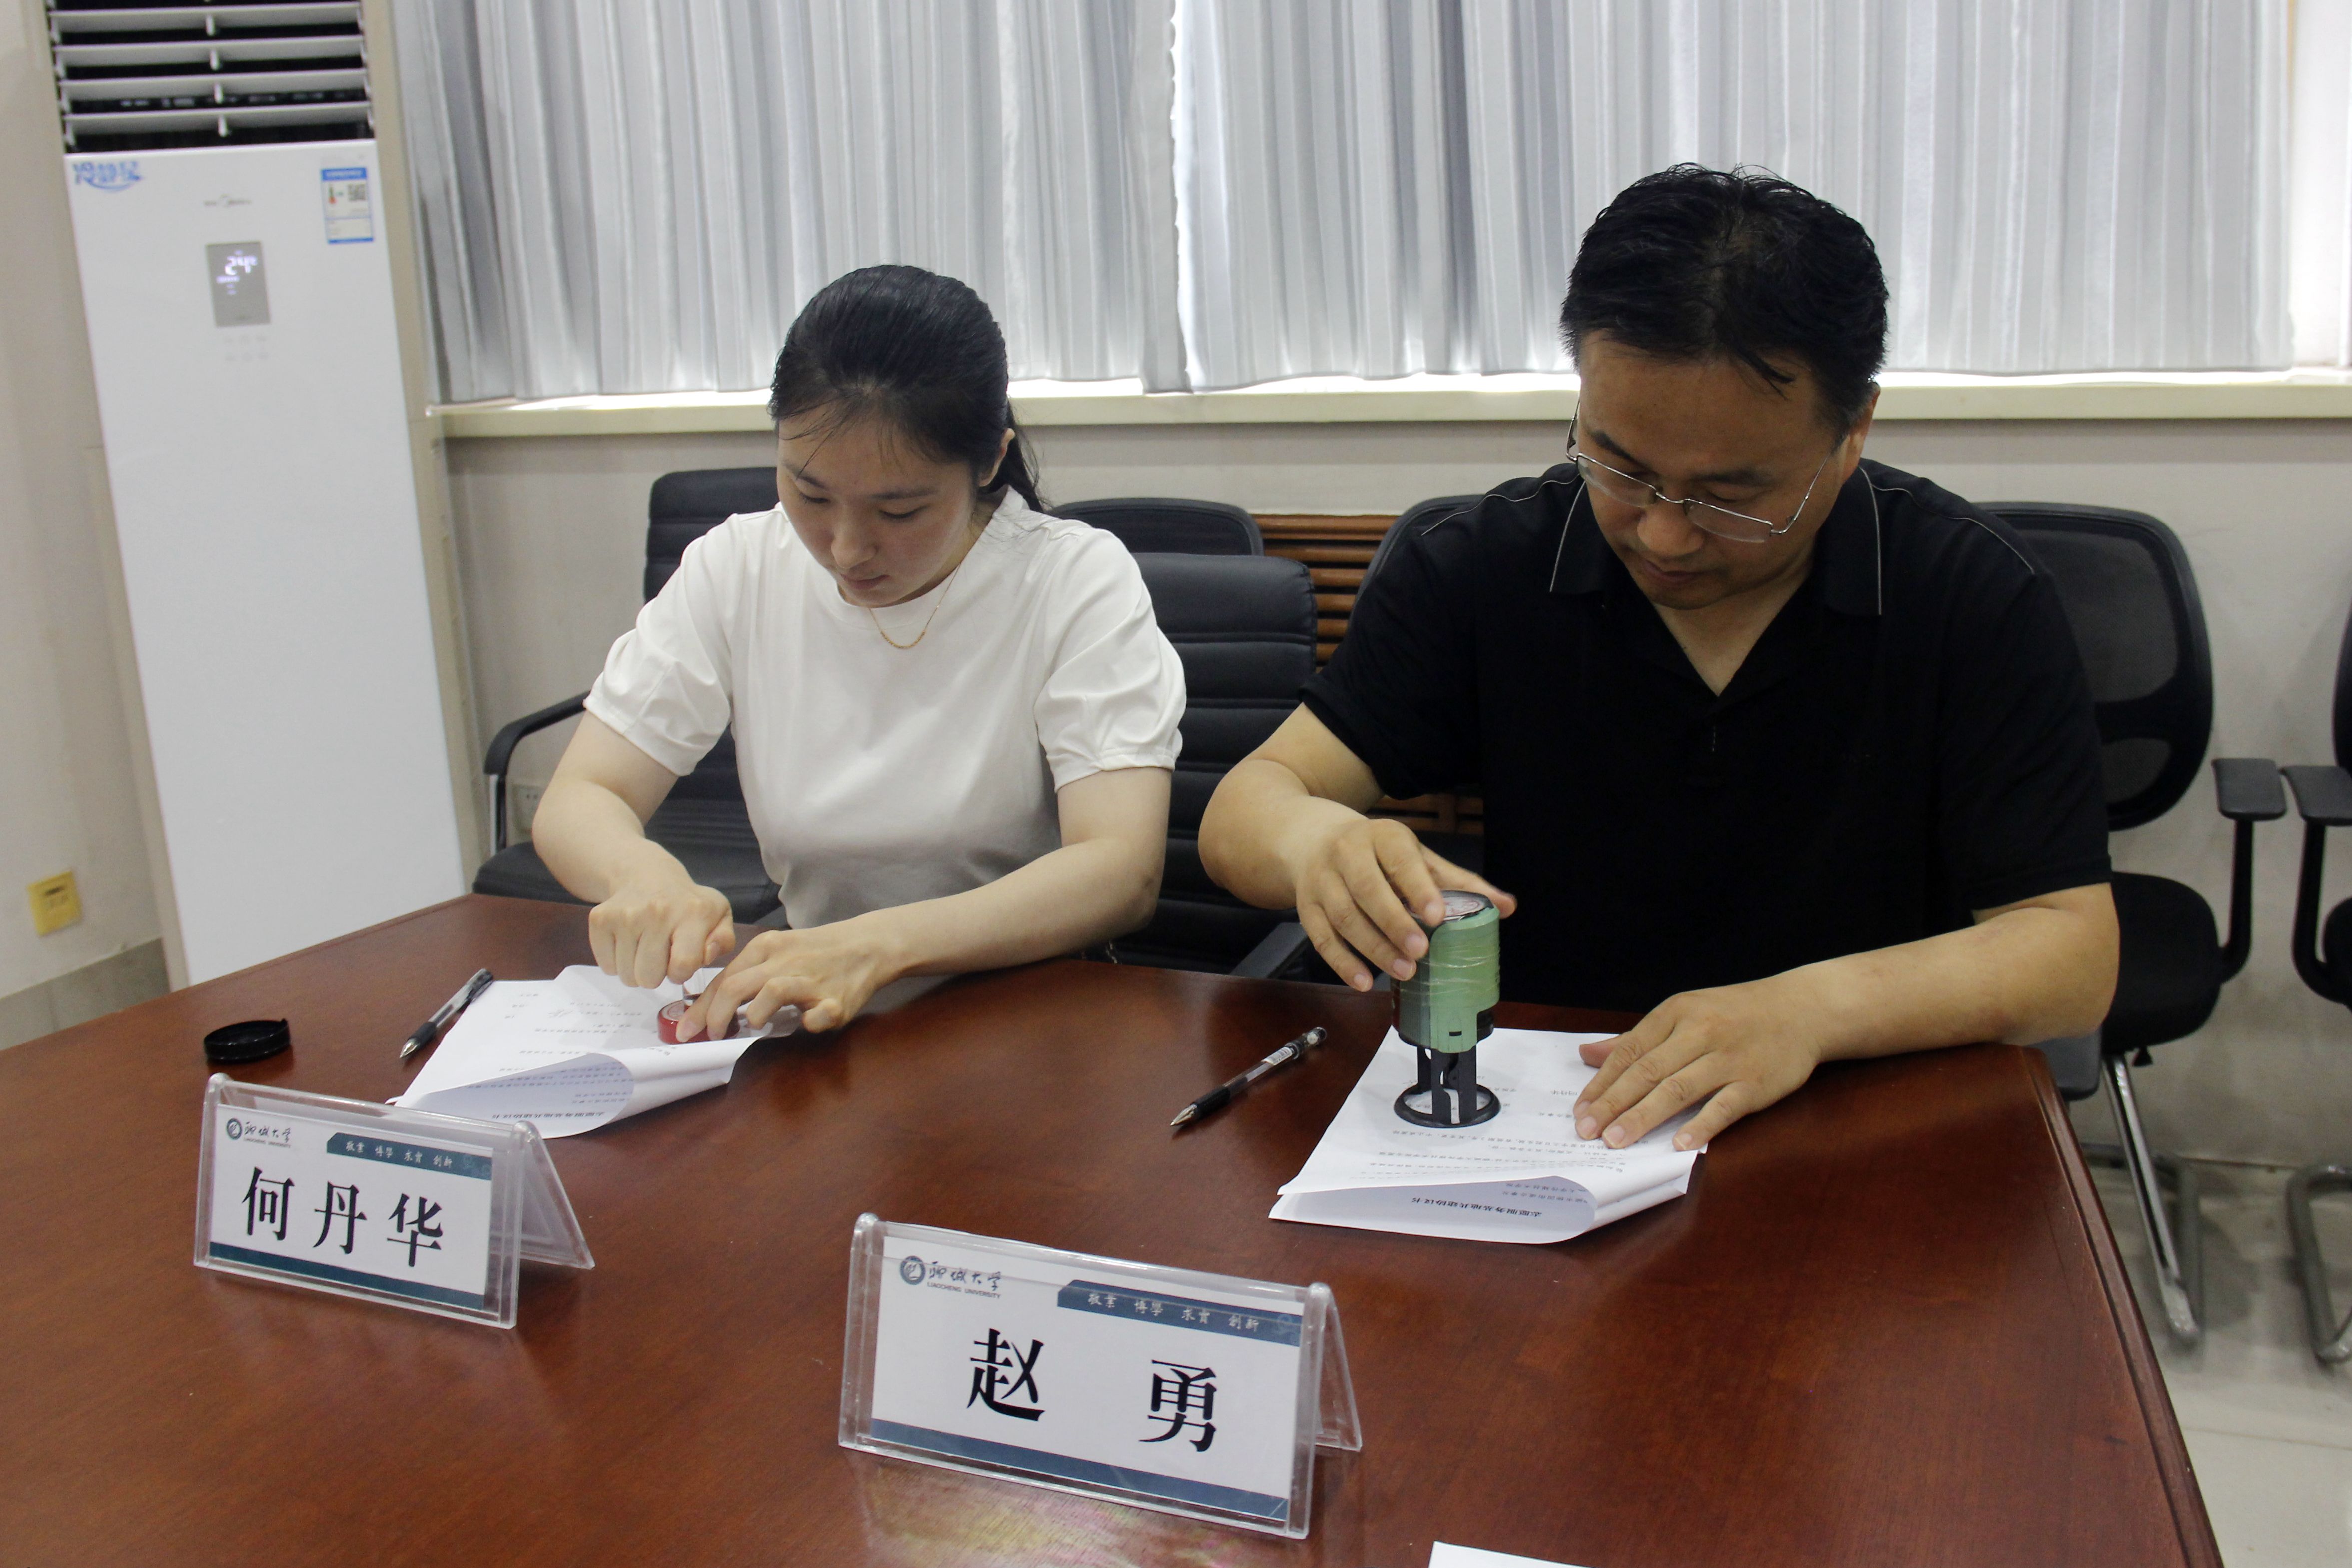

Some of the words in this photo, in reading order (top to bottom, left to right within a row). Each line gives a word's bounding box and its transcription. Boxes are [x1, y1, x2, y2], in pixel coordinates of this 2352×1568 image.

[242, 1166, 444, 1267] 何丹华
[927, 1281, 961, 1293] LIAOCHENG
[965, 1288, 1001, 1299] UNIVERSITY
[967, 1328, 1217, 1453] 赵勇
